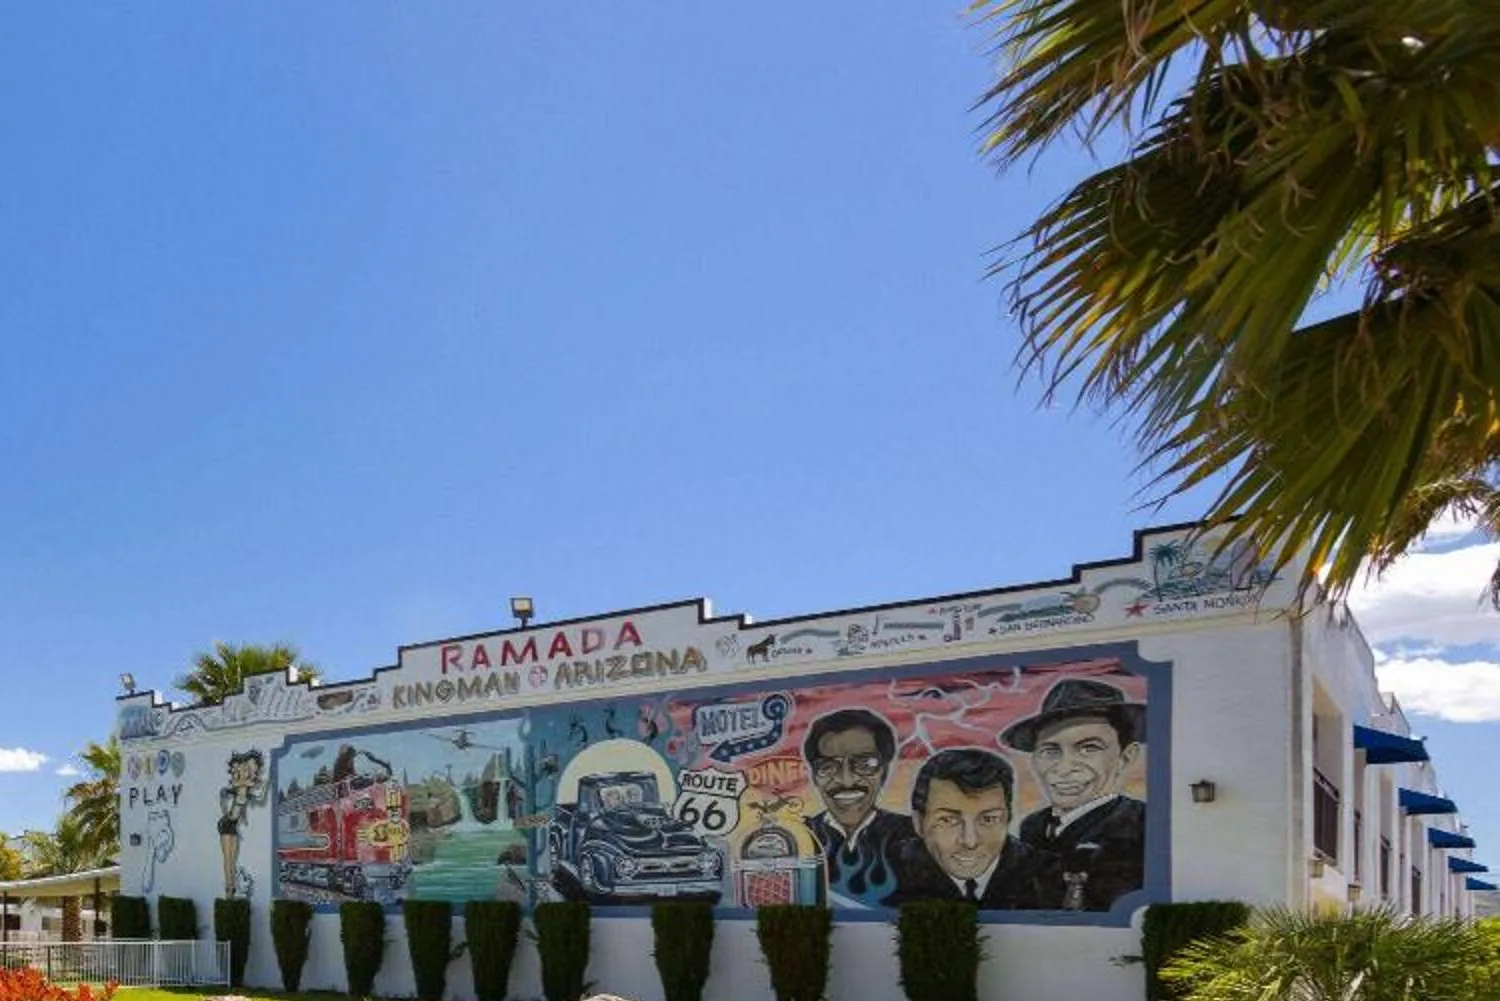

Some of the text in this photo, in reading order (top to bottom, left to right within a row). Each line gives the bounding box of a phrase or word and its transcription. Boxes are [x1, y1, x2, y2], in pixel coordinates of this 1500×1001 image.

[440, 621, 643, 675] RAMADA
[393, 646, 705, 709] KINGMAN ARIZONA
[701, 707, 764, 737] MOTEL
[129, 783, 183, 809] PLAY
[682, 773, 738, 792] ROUTE
[679, 797, 727, 831] 66
